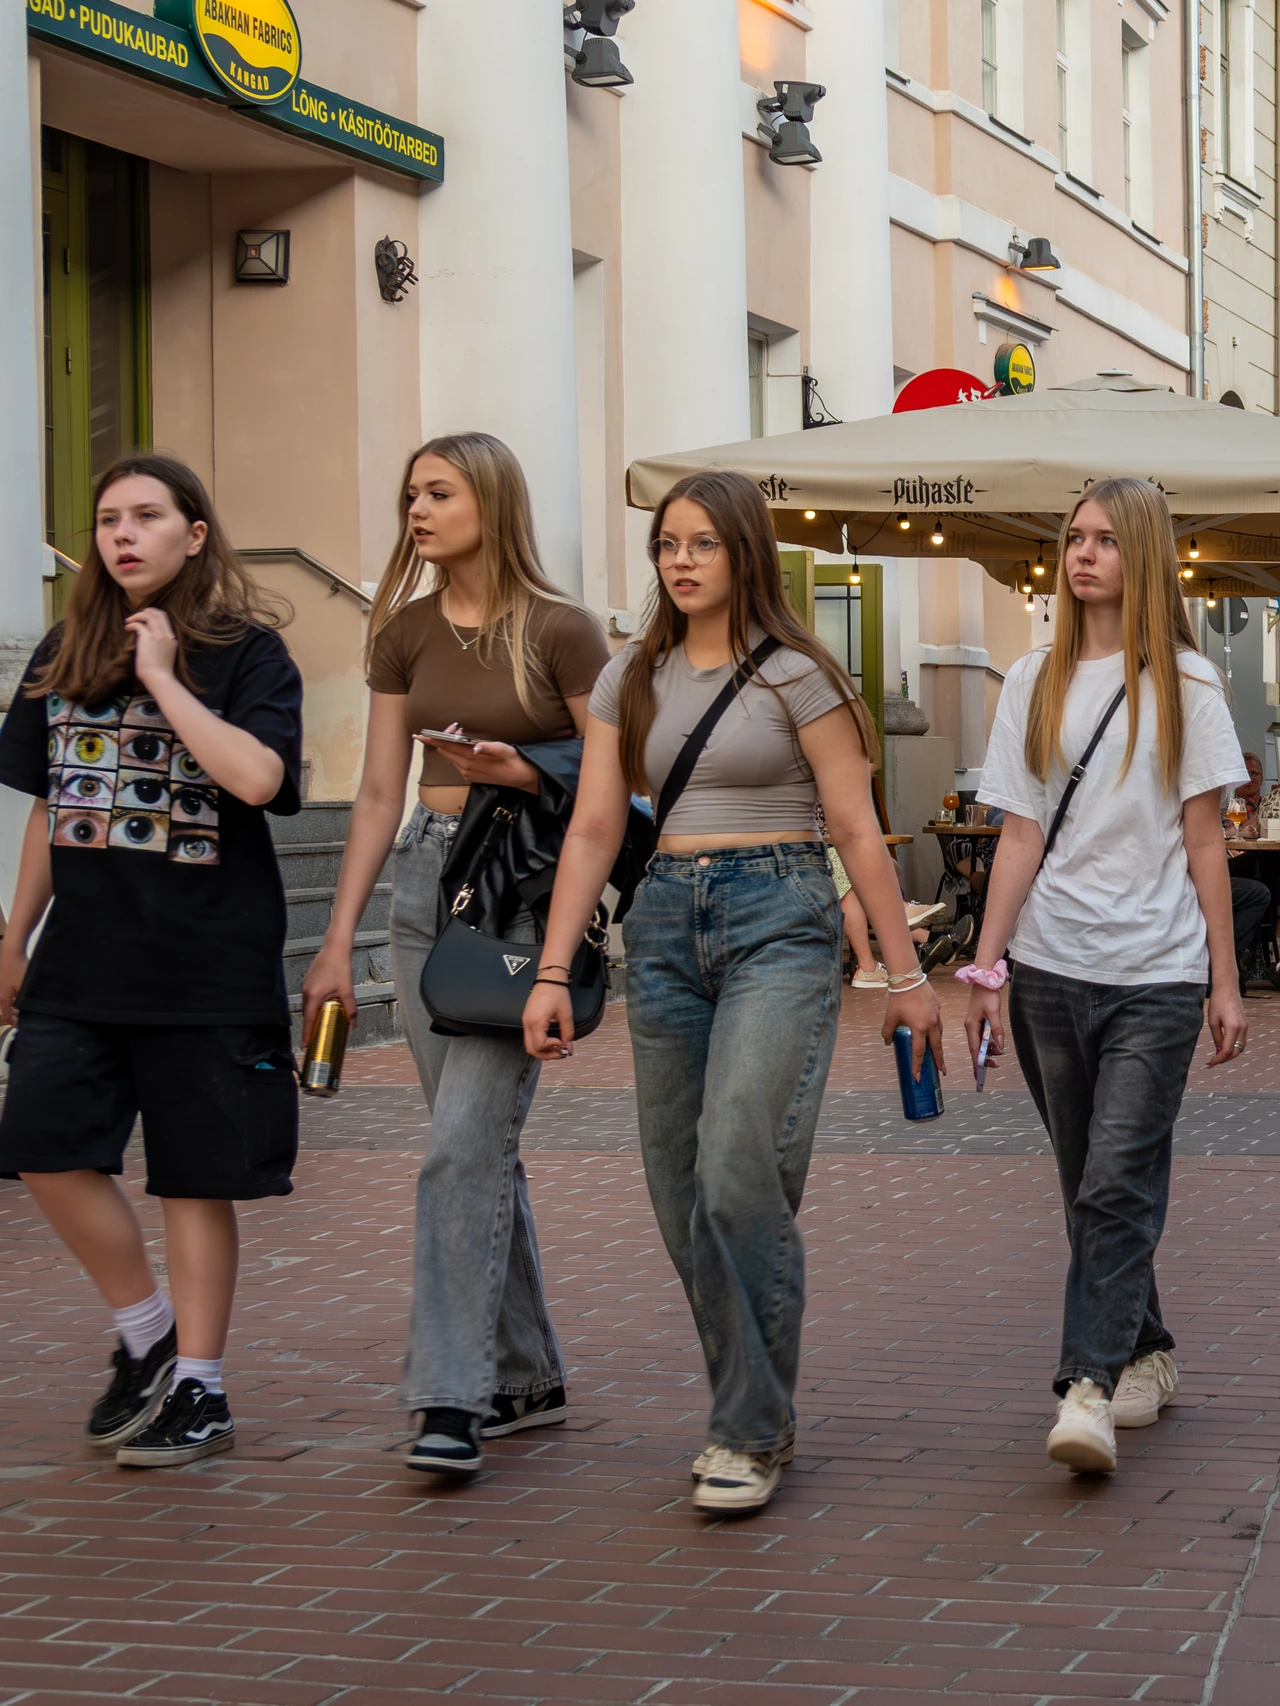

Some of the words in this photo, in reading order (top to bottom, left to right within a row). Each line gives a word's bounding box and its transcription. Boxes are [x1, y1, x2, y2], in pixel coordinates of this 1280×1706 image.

[27, 0, 65, 21] GAD
[79, 4, 189, 68] PUDUKAUBAD
[204, 0, 250, 36] ABAKHAN
[253, 17, 292, 54] FABRICS
[229, 61, 269, 91] KANGAD
[292, 86, 327, 124] LÕNG
[339, 108, 437, 166] KÄSITÖÖTARBED
